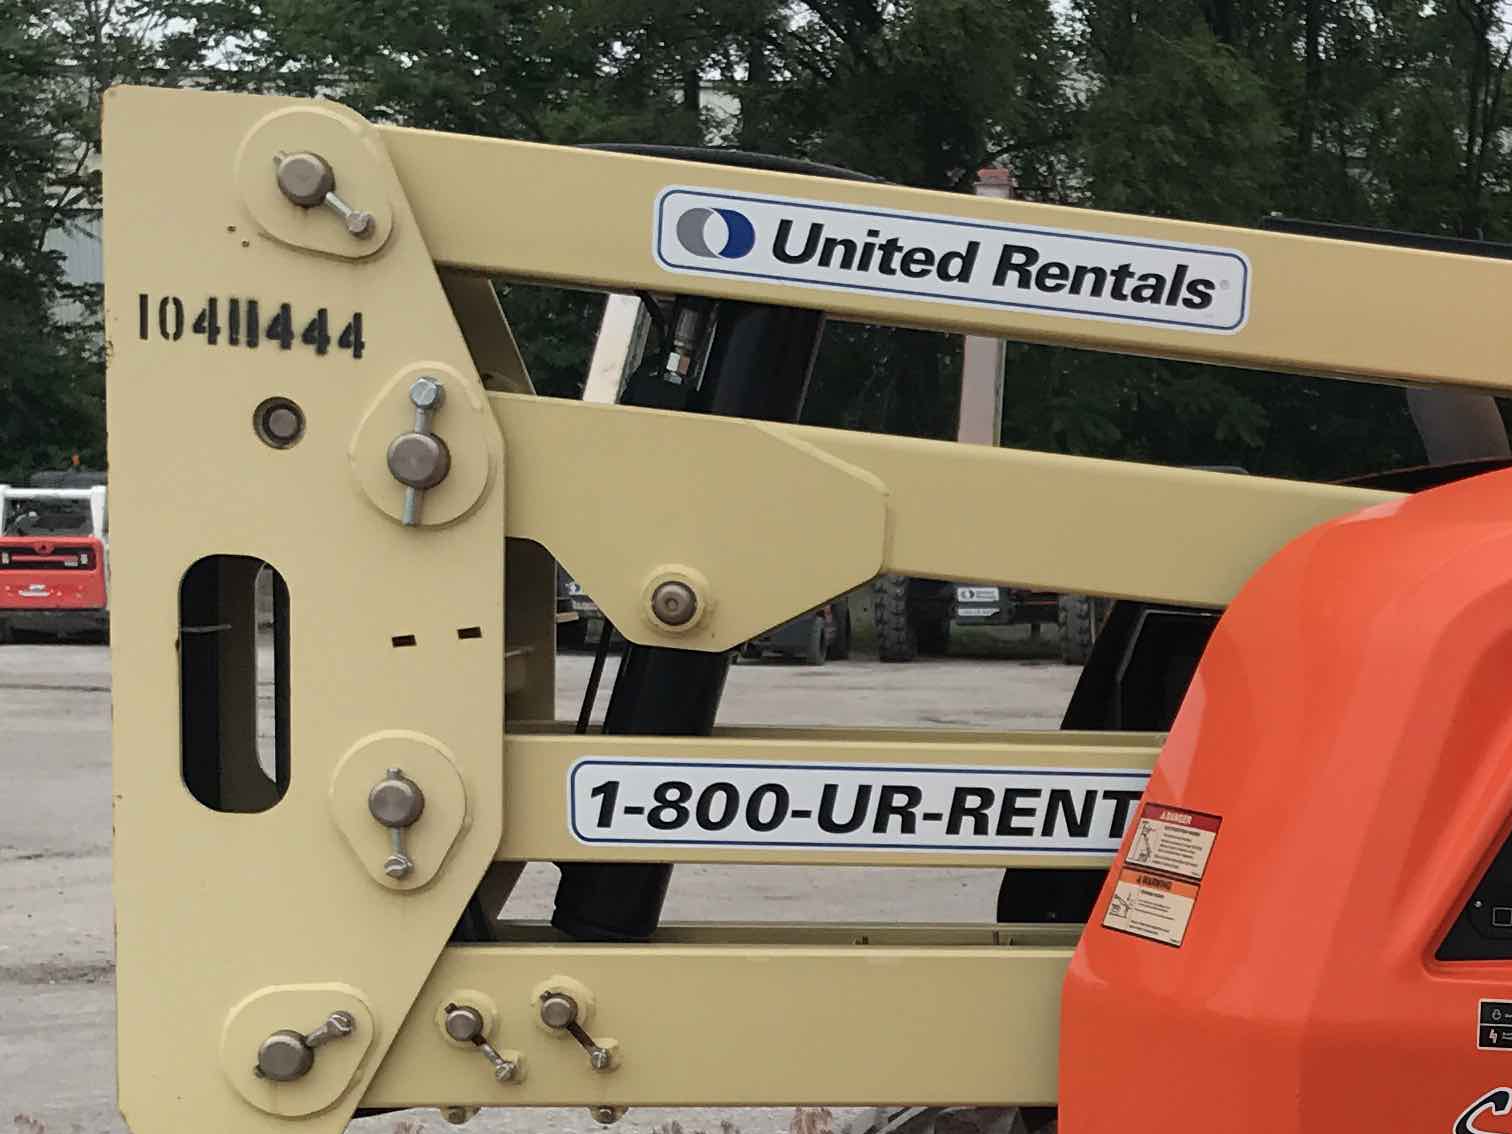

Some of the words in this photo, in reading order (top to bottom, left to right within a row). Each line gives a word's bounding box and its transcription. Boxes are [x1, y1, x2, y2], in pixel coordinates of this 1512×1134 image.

[772, 219, 980, 284] United
[992, 244, 1216, 310] Rentals
[139, 293, 365, 360] 10411444
